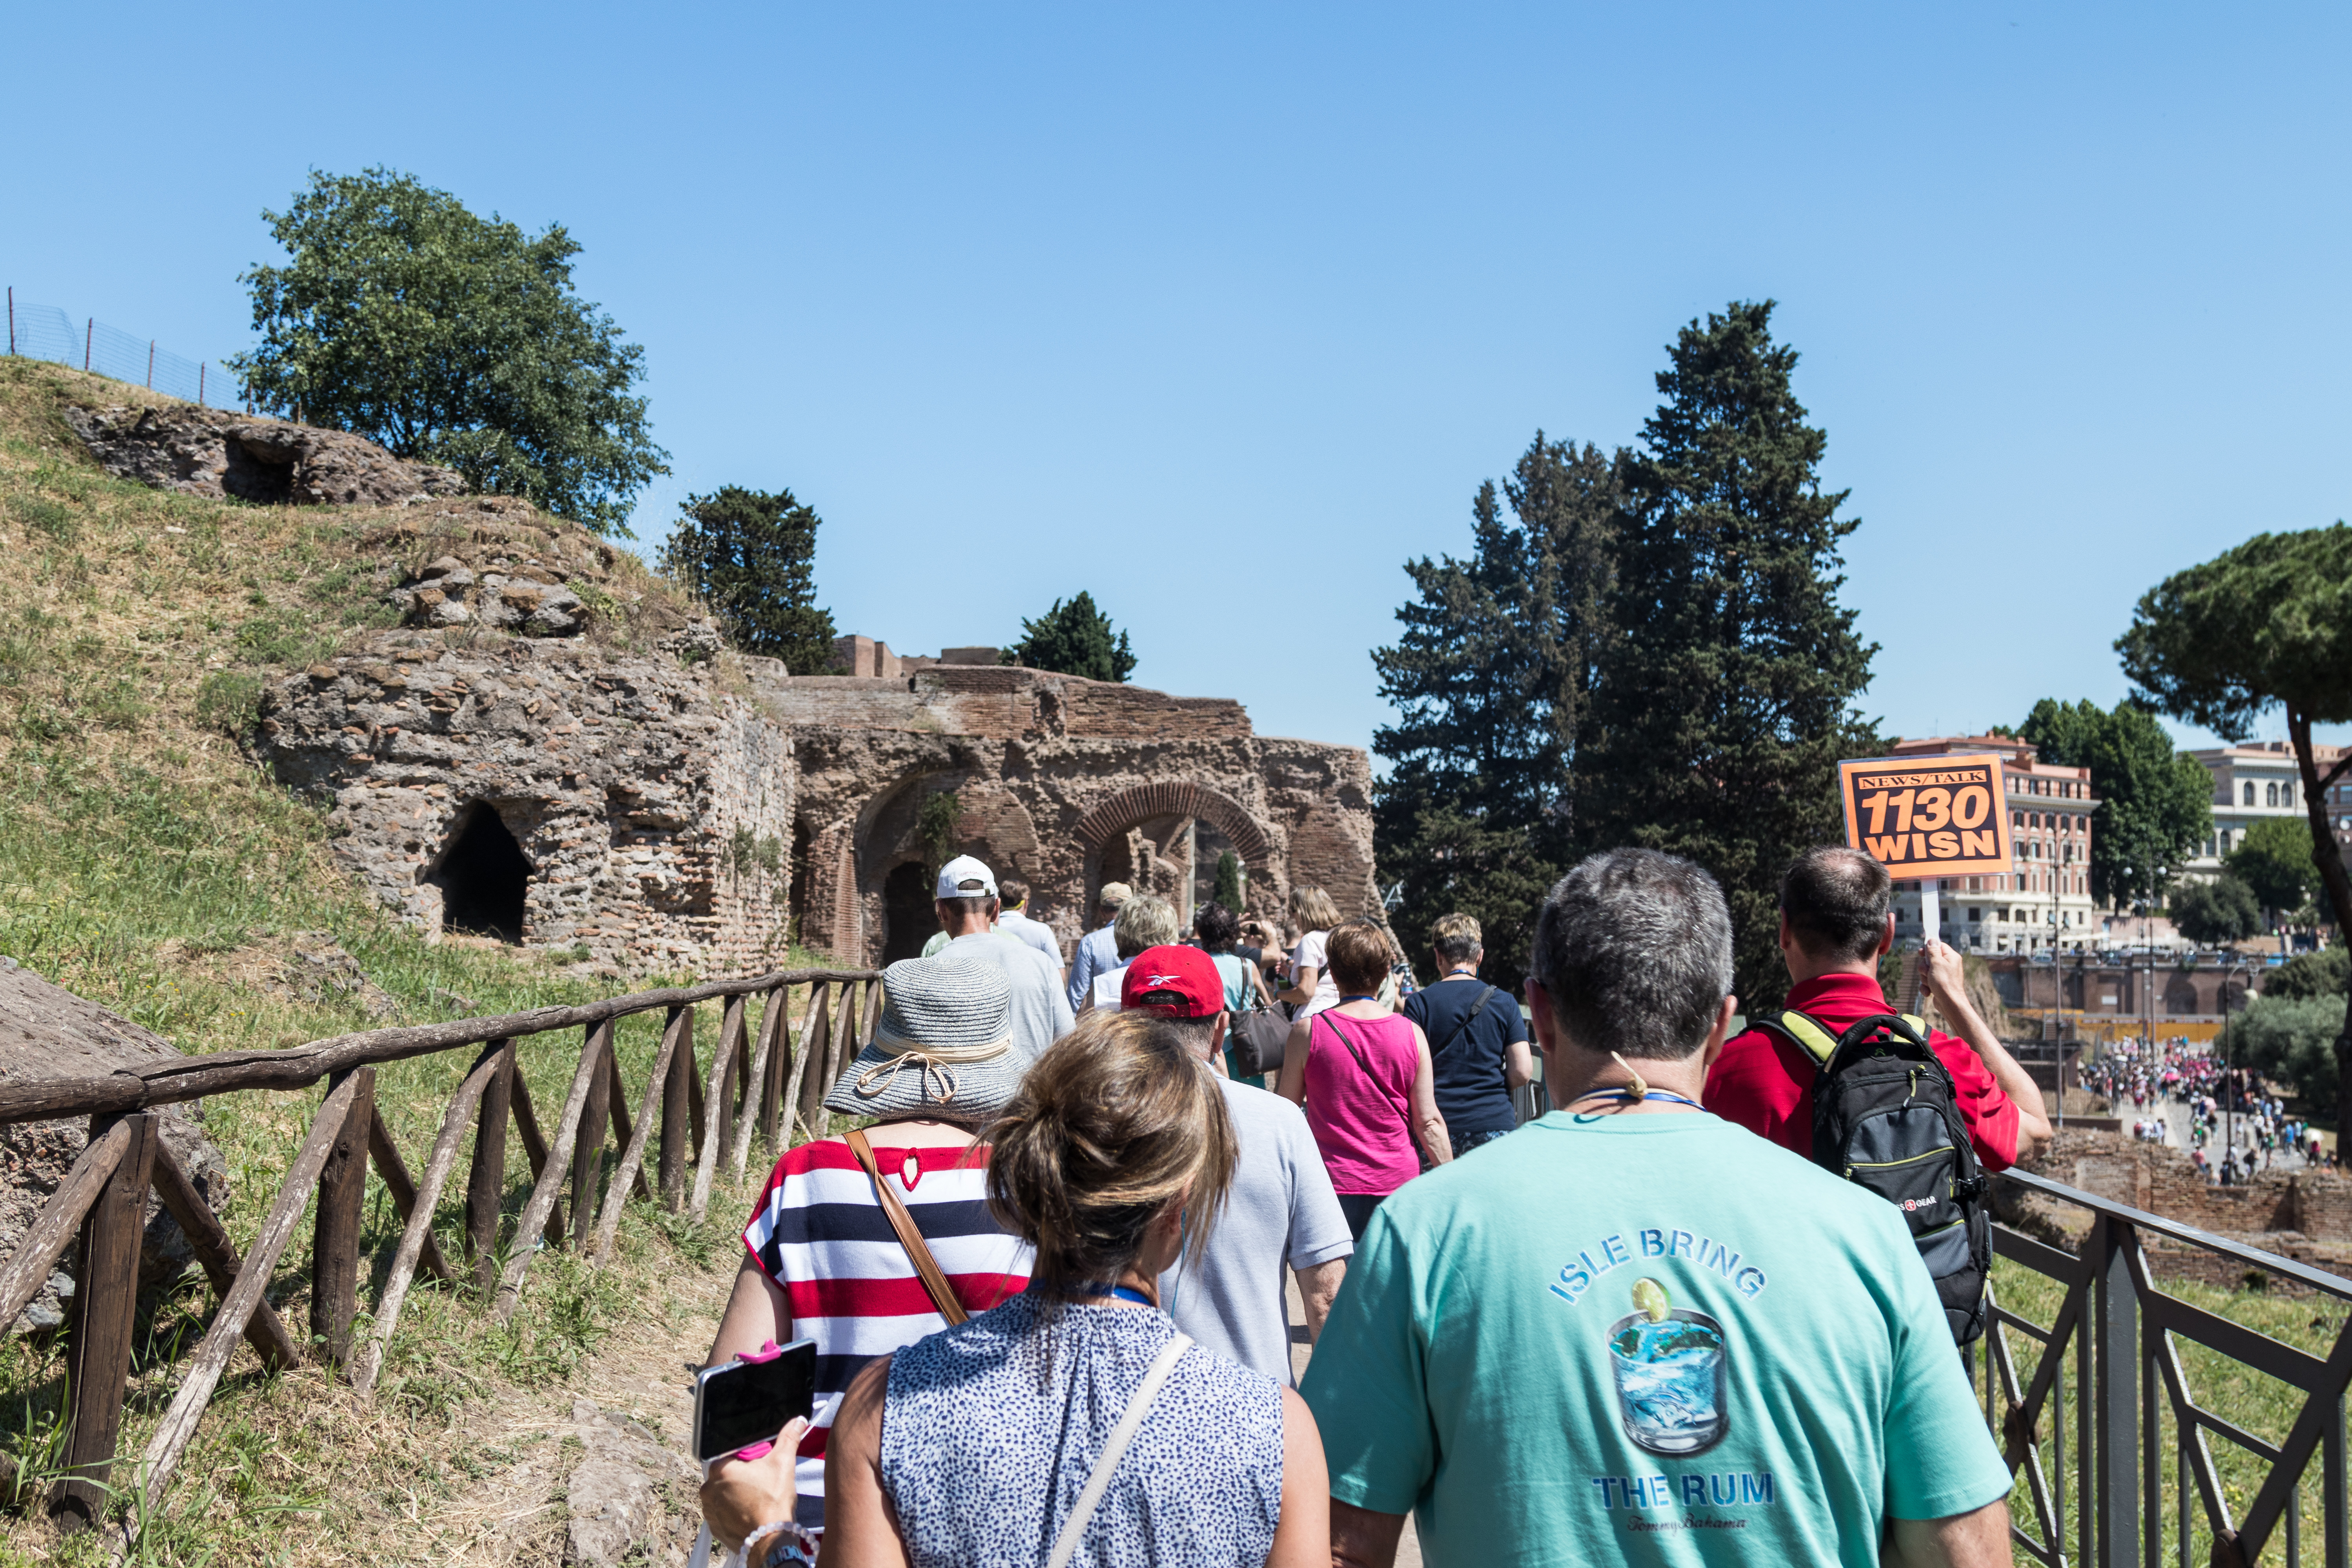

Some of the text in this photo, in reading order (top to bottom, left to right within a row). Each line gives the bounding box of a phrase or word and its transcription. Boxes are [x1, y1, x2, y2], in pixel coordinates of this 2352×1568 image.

[1861, 771, 1985, 788] NEWS/TALK
[1862, 786, 1990, 834] 1130
[1864, 830, 1996, 862] WISN
[1916, 1196, 1937, 1207] GEAR
[1548, 1228, 1768, 1306] ISLE BRING
[1592, 1472, 1775, 1510] THE RUM
[1679, 1512, 1749, 1529] Bahama
